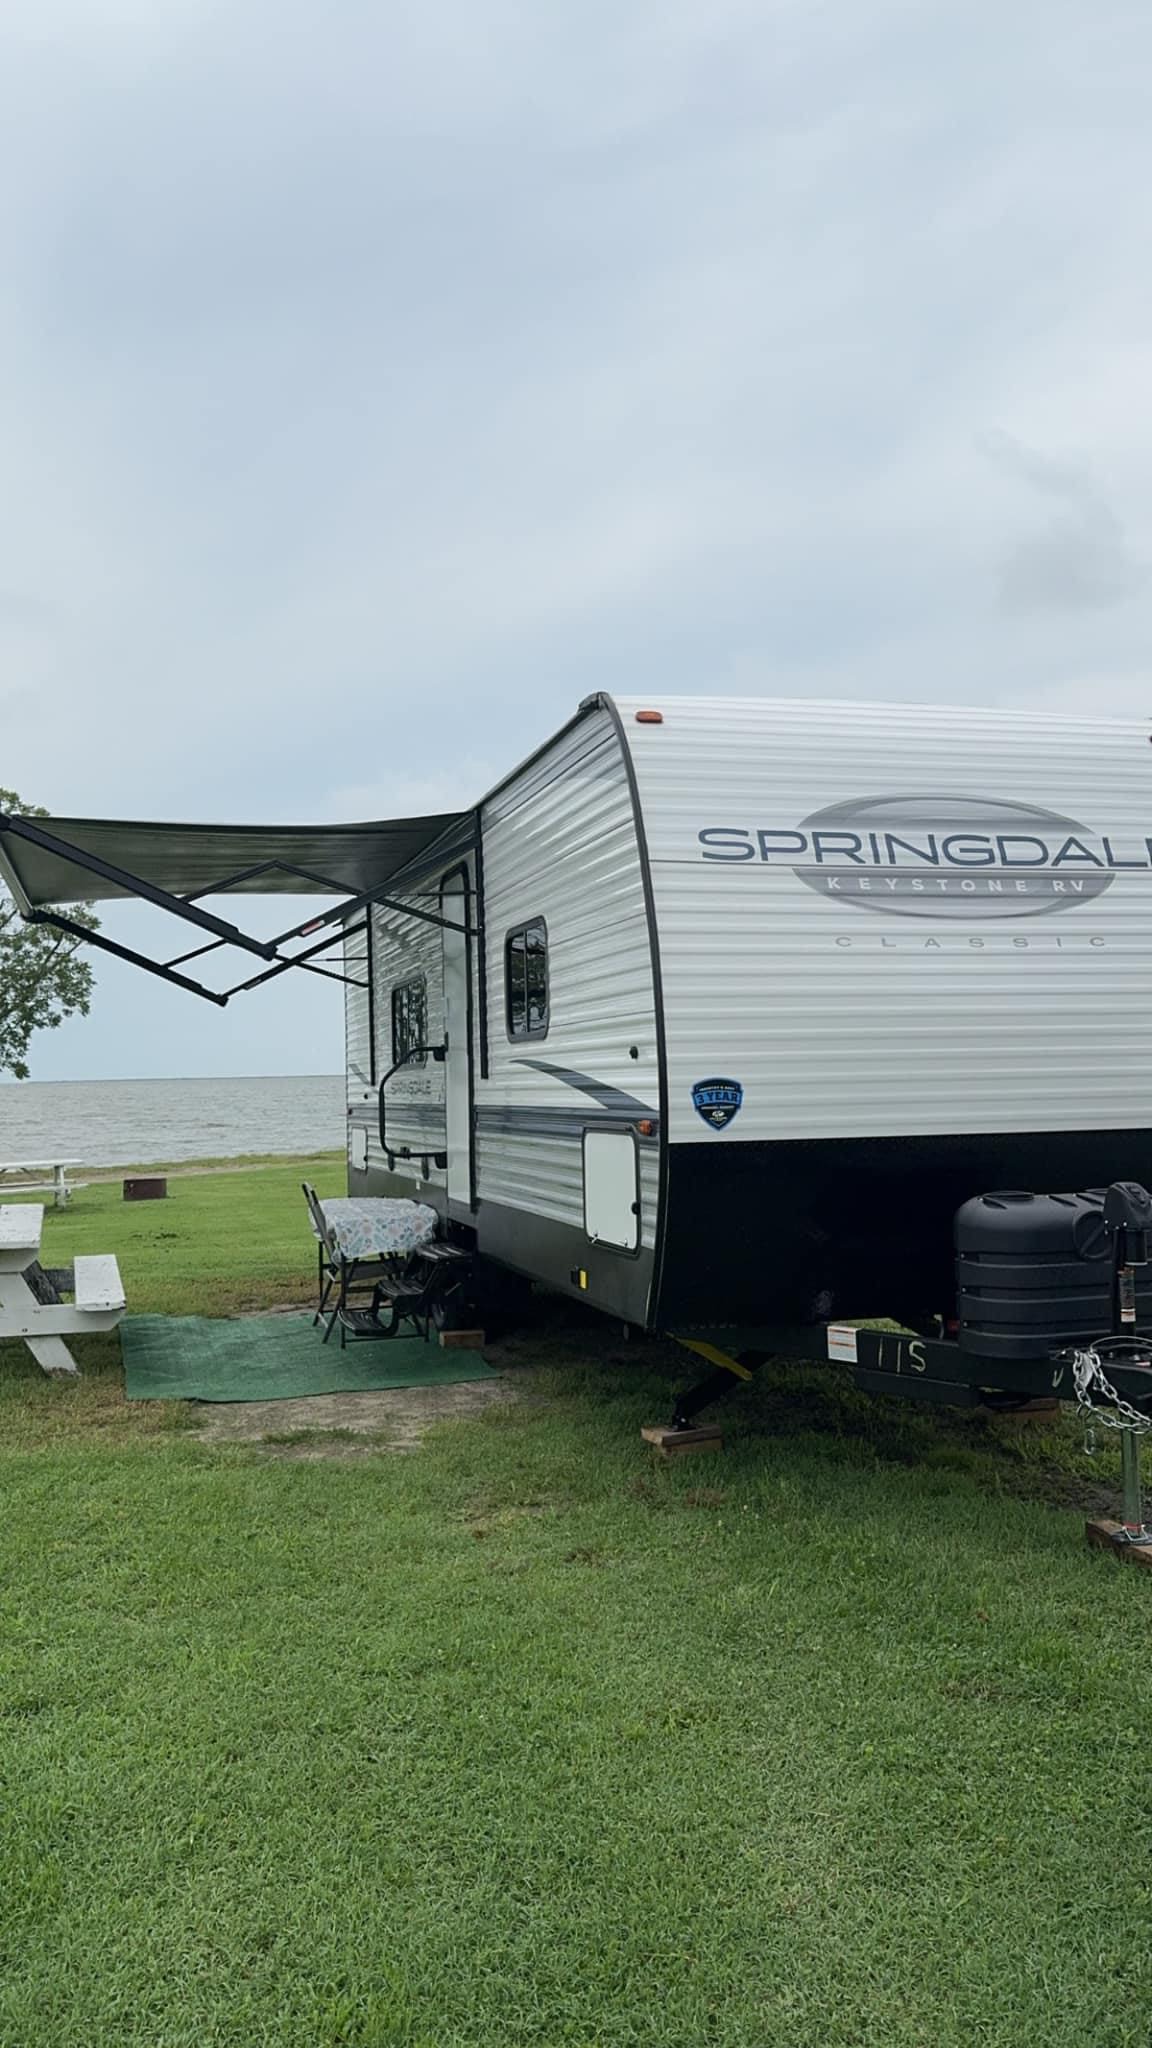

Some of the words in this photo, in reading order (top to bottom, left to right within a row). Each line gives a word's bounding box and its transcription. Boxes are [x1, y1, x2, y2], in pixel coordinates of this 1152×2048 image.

[698, 828, 1152, 868] SPRINGDAL
[827, 877, 1028, 892] KEYSTONE
[1053, 879, 1084, 892] RV
[835, 936, 1106, 949] CLASSIC
[697, 1094, 705, 1104] 3
[707, 1092, 738, 1103] YEAR
